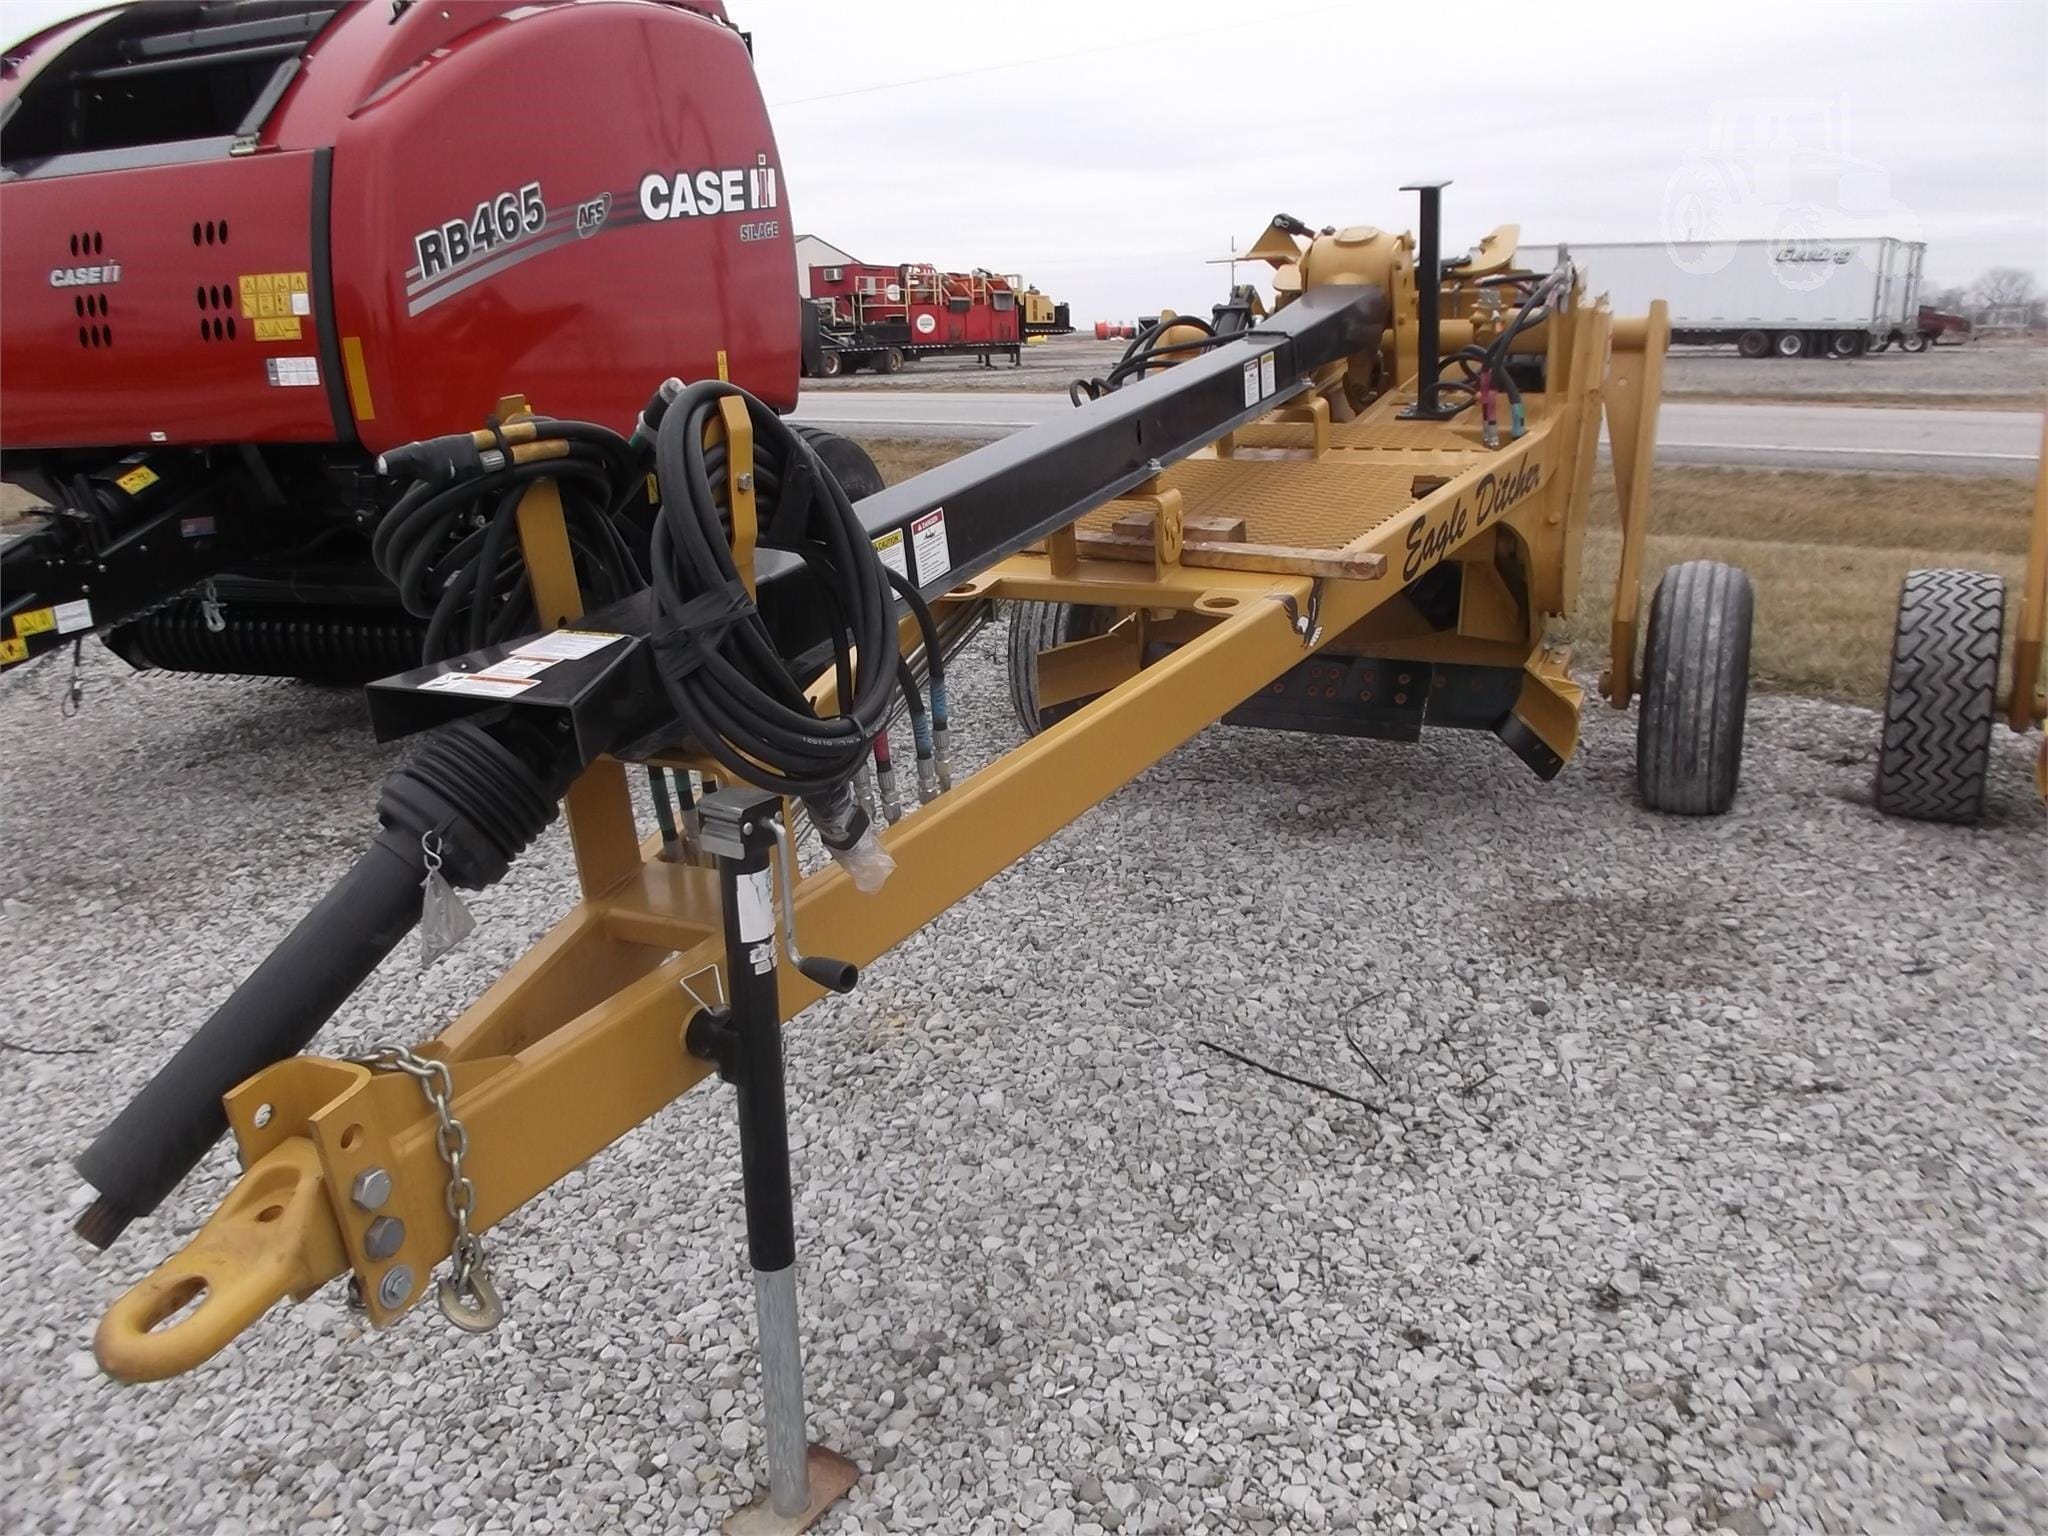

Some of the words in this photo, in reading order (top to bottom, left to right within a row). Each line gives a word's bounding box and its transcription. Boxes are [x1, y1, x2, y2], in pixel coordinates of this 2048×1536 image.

[640, 170, 745, 221] CASE
[576, 199, 605, 229] AFS
[415, 182, 548, 280] RB465
[740, 221, 779, 242] SILAGE
[50, 266, 101, 287] CASE
[1402, 498, 1467, 582] Eagle
[1475, 452, 1540, 527] Ditcher
[878, 534, 900, 550] CAUTION
